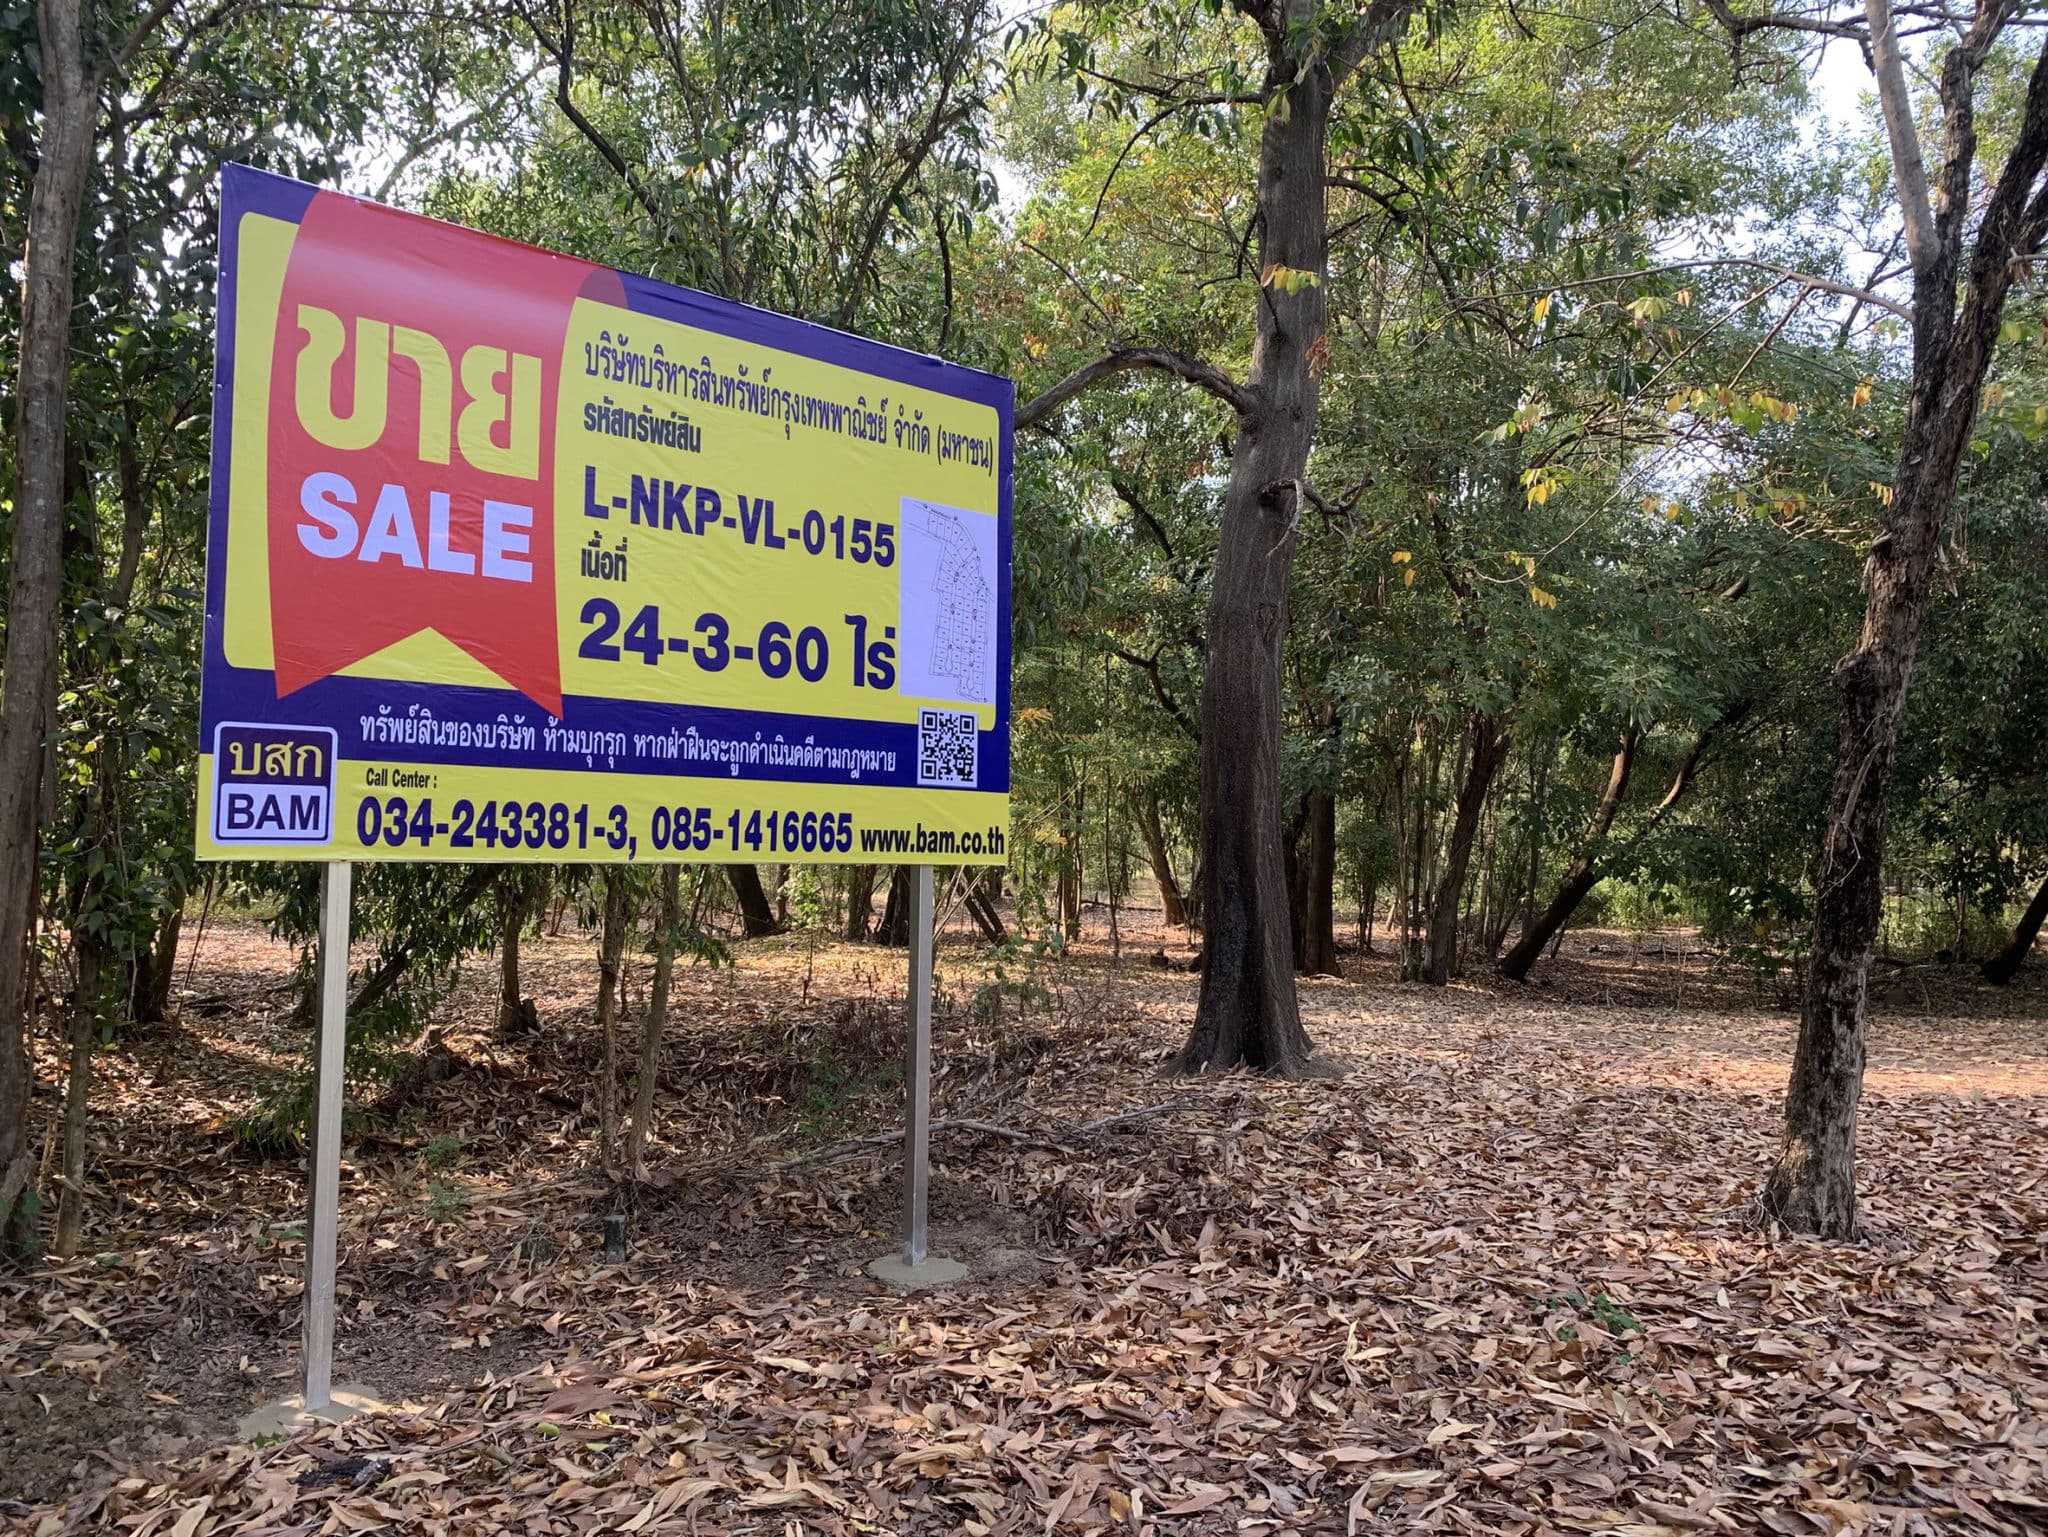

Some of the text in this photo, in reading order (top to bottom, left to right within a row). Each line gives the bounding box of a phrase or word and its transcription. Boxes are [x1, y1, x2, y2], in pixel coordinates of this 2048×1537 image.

[295, 303, 542, 481] ขาย
[584, 396, 701, 453] รหัสทรัพย์สิน
[585, 330, 994, 477] บริษัทบริหารสินทรัพย์กรุงเทพพาณิชย์ จำกัด (มหาชน)
[297, 471, 533, 583] SALE
[583, 465, 896, 568] L-NKP-VL-0155
[581, 530, 628, 582] เนื้อที่
[578, 597, 829, 683] 24-3-60
[845, 613, 896, 690] ไร่
[229, 740, 322, 778] บสก
[360, 704, 896, 779] ทรัพย์สินของบริษัท ห้ามบุกรุก หากฝ่าฝืนจะถูกดำเนินคดีตามกฎหมาย
[227, 793, 320, 831] BAM
[366, 767, 388, 788] Call
[356, 796, 1005, 861] 034-243381-3, 085-1416665 www.bam.co.th
